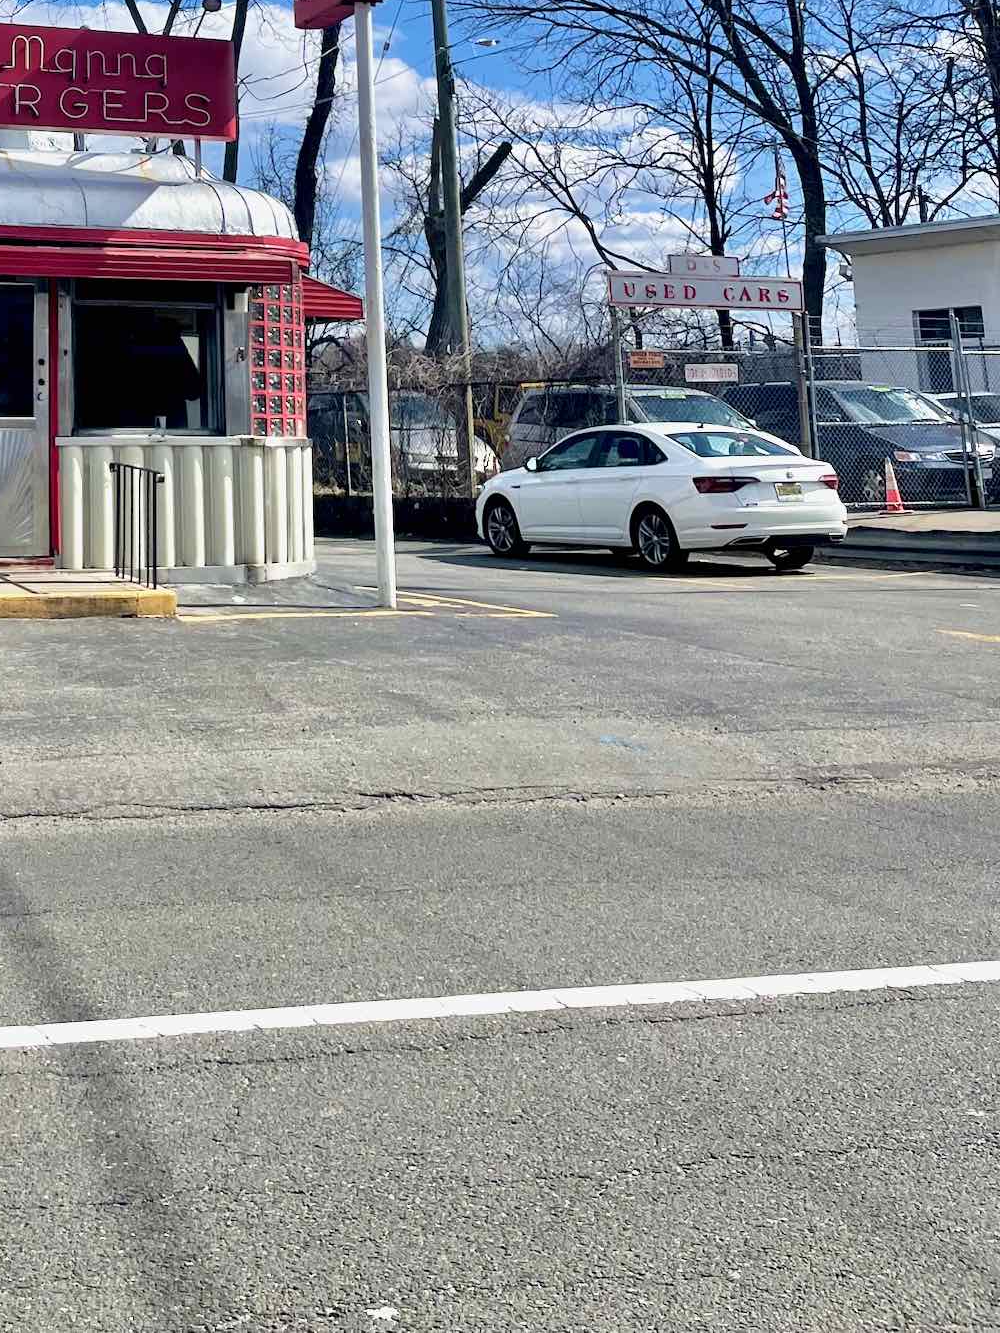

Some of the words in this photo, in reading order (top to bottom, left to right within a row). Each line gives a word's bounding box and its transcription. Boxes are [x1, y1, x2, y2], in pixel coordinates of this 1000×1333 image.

[1, 33, 168, 86] Manna
[623, 281, 697, 300] USED
[722, 285, 790, 304] CARS
